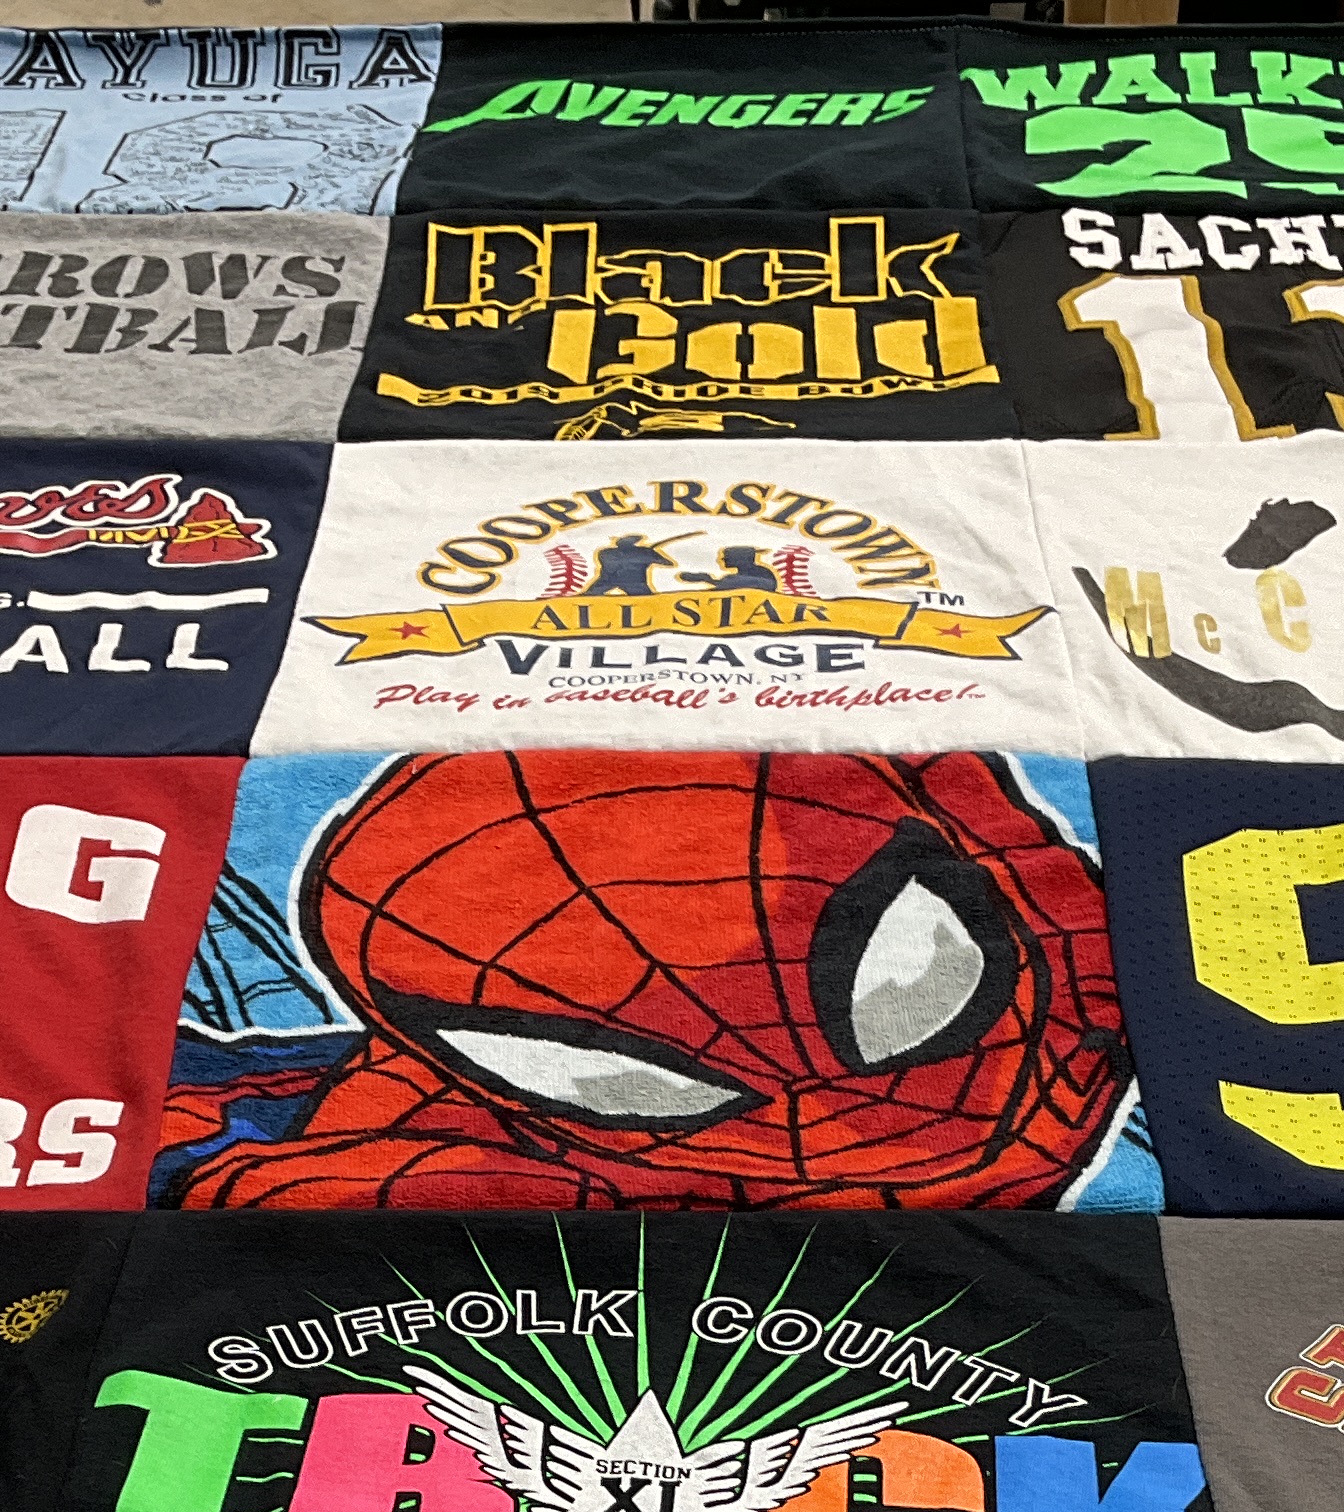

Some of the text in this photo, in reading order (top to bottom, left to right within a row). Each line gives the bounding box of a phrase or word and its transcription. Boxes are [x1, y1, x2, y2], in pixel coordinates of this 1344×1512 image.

[422, 79, 935, 132] AVENGERS
[424, 215, 960, 310] Black
[547, 297, 986, 384] Gold
[417, 479, 966, 607] COOPERSTOWN TM
[528, 595, 833, 633] ALL STAR
[493, 639, 869, 678] VILLAGE
[372, 682, 484, 713] Play
[492, 693, 532, 712] in
[208, 1288, 1088, 1429] SUFFOLK COUNTY
[595, 1459, 692, 1479] SECTION
